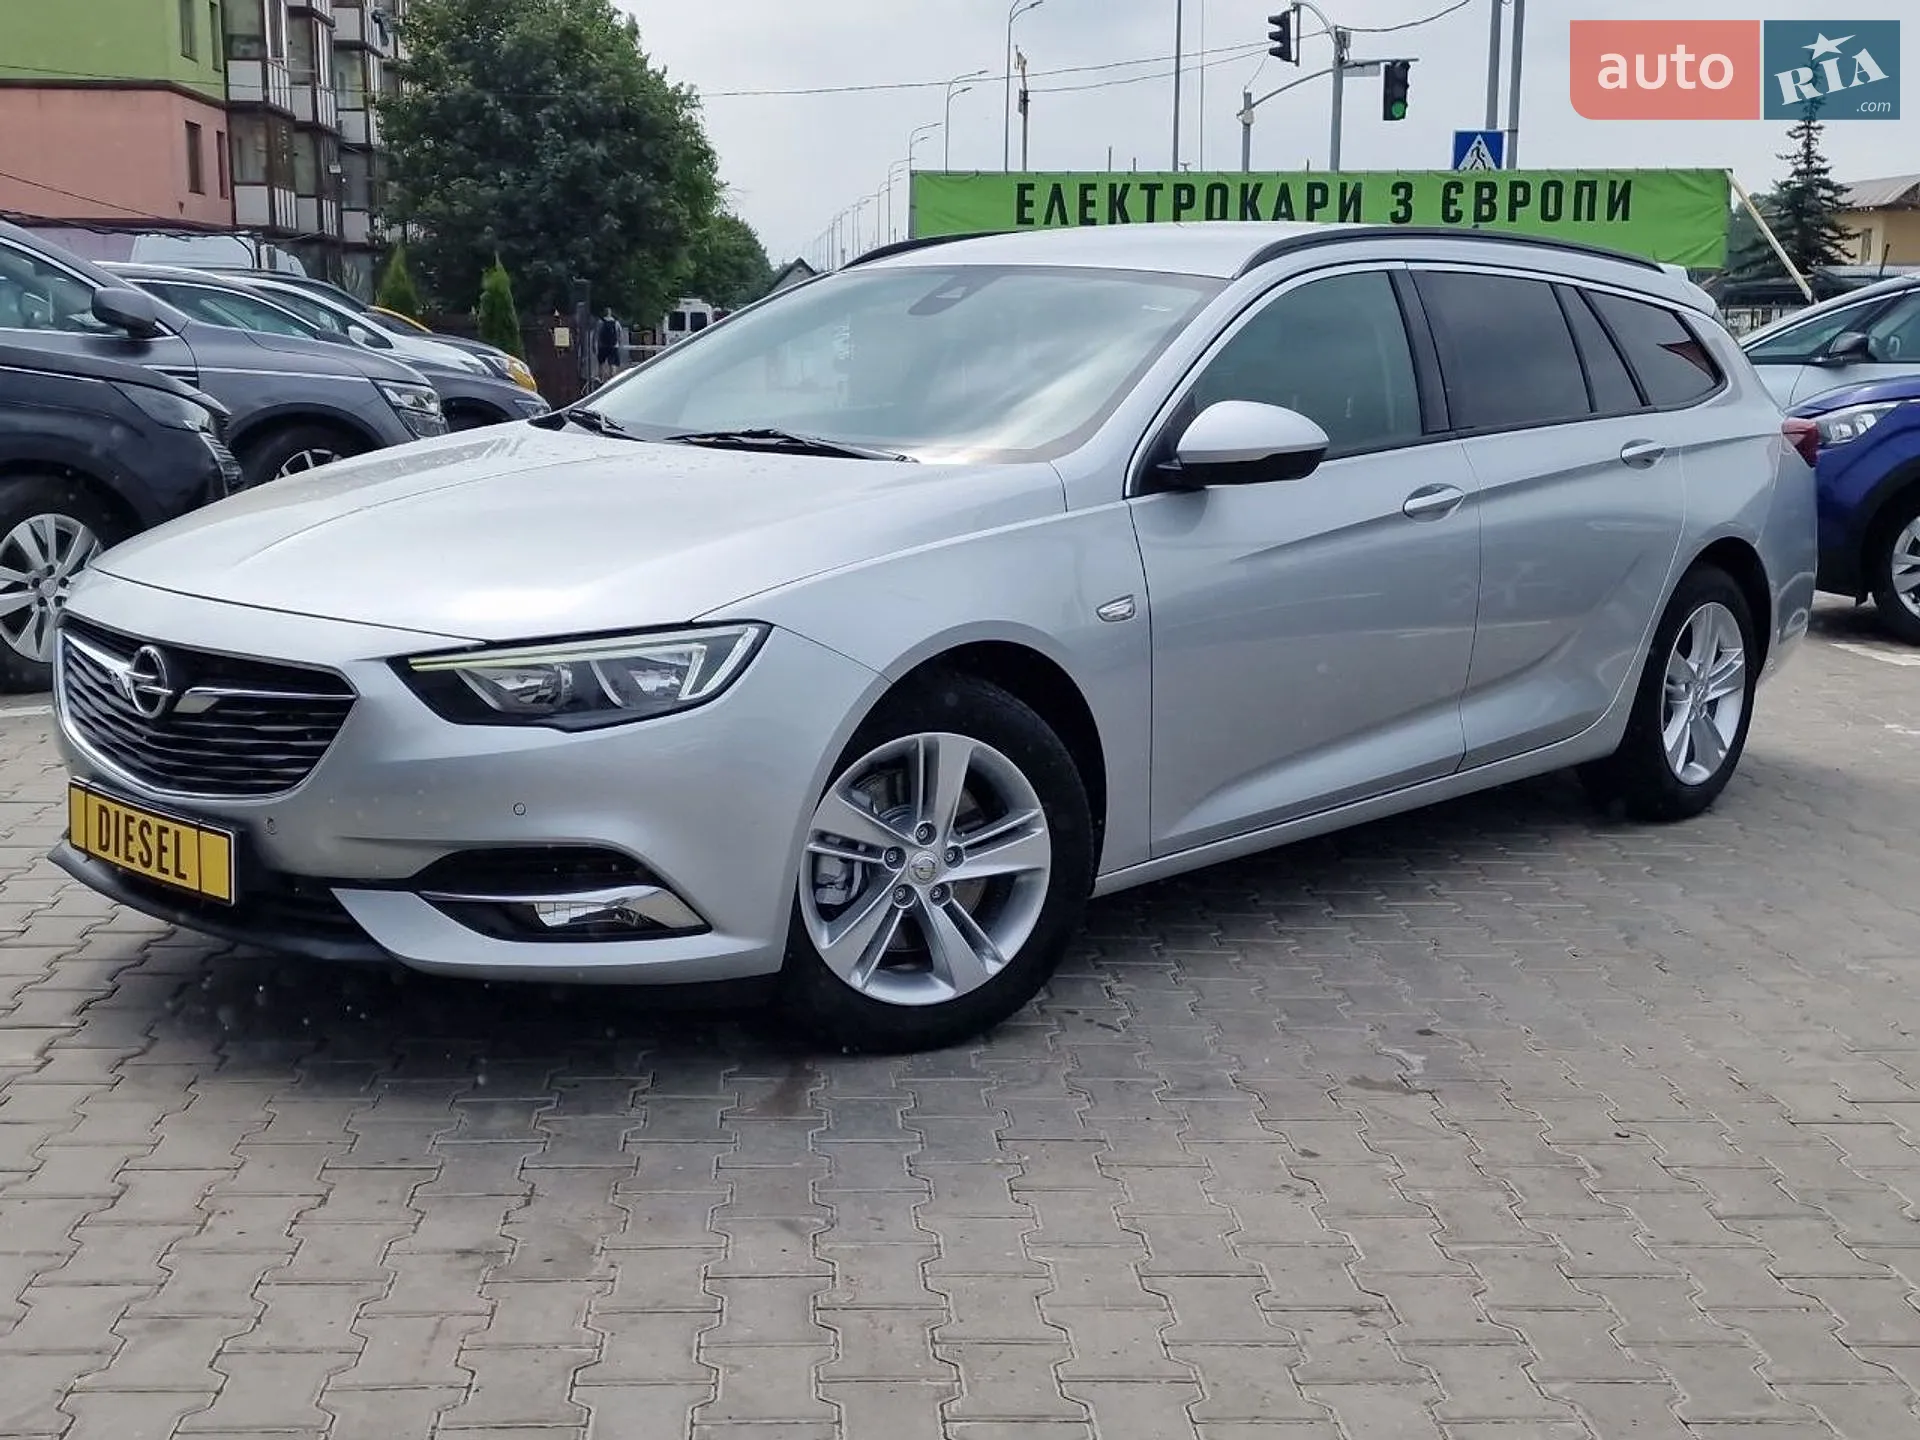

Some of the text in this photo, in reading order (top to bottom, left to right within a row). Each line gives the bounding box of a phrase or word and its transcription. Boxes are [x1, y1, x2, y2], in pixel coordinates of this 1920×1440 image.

[1015, 181, 1363, 226] ЕЛЕКТРОКАРИ
[1441, 179, 1633, 224] ЄВРОПИ
[97, 803, 188, 881] DIESEL
